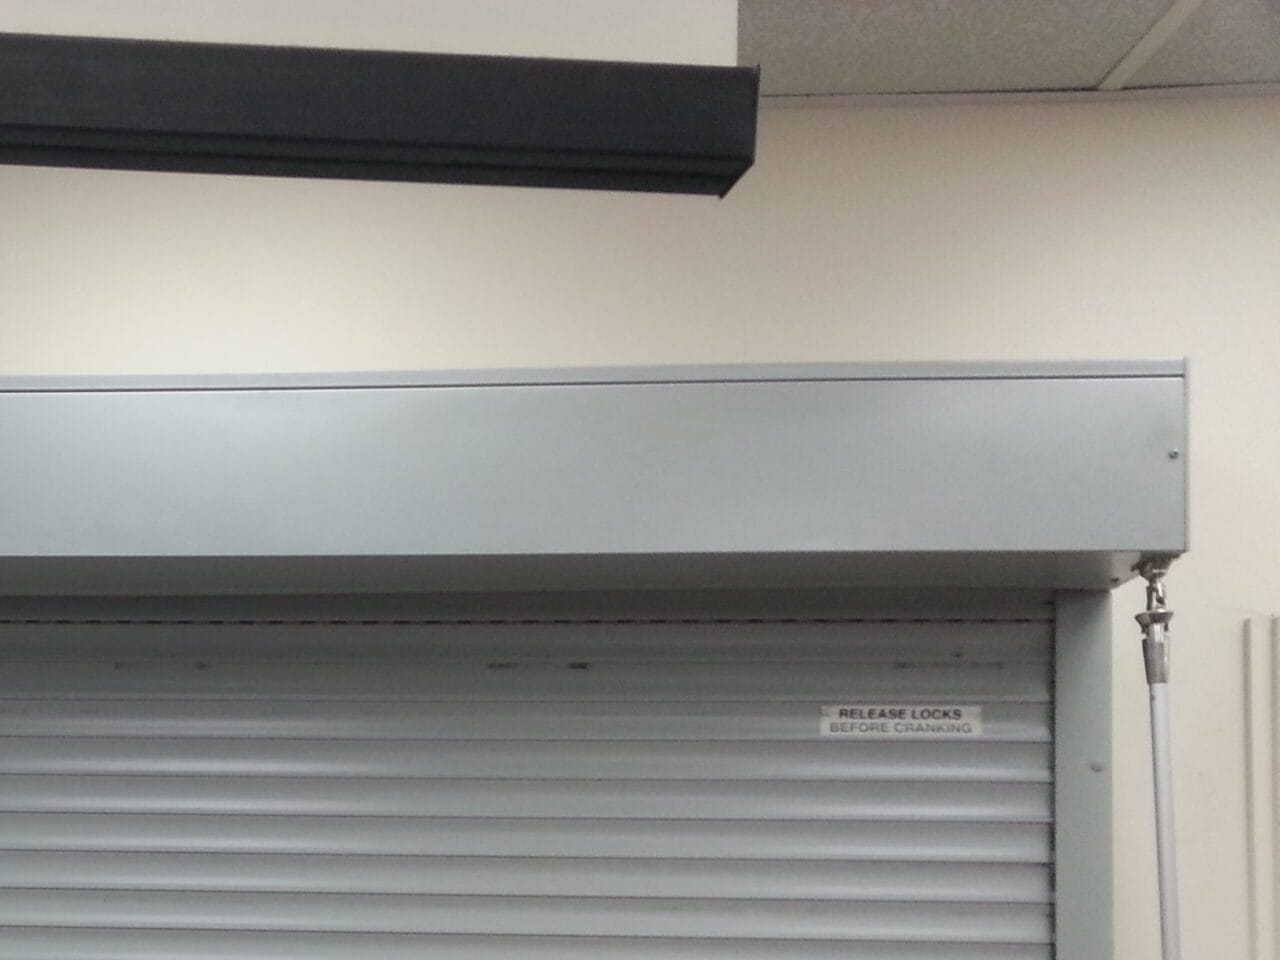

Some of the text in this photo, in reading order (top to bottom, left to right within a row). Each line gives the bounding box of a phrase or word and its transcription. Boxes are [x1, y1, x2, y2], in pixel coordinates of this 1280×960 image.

[839, 708, 962, 720] RELEASE LOCKS
[830, 722, 972, 734] BEFORE CRANKING
